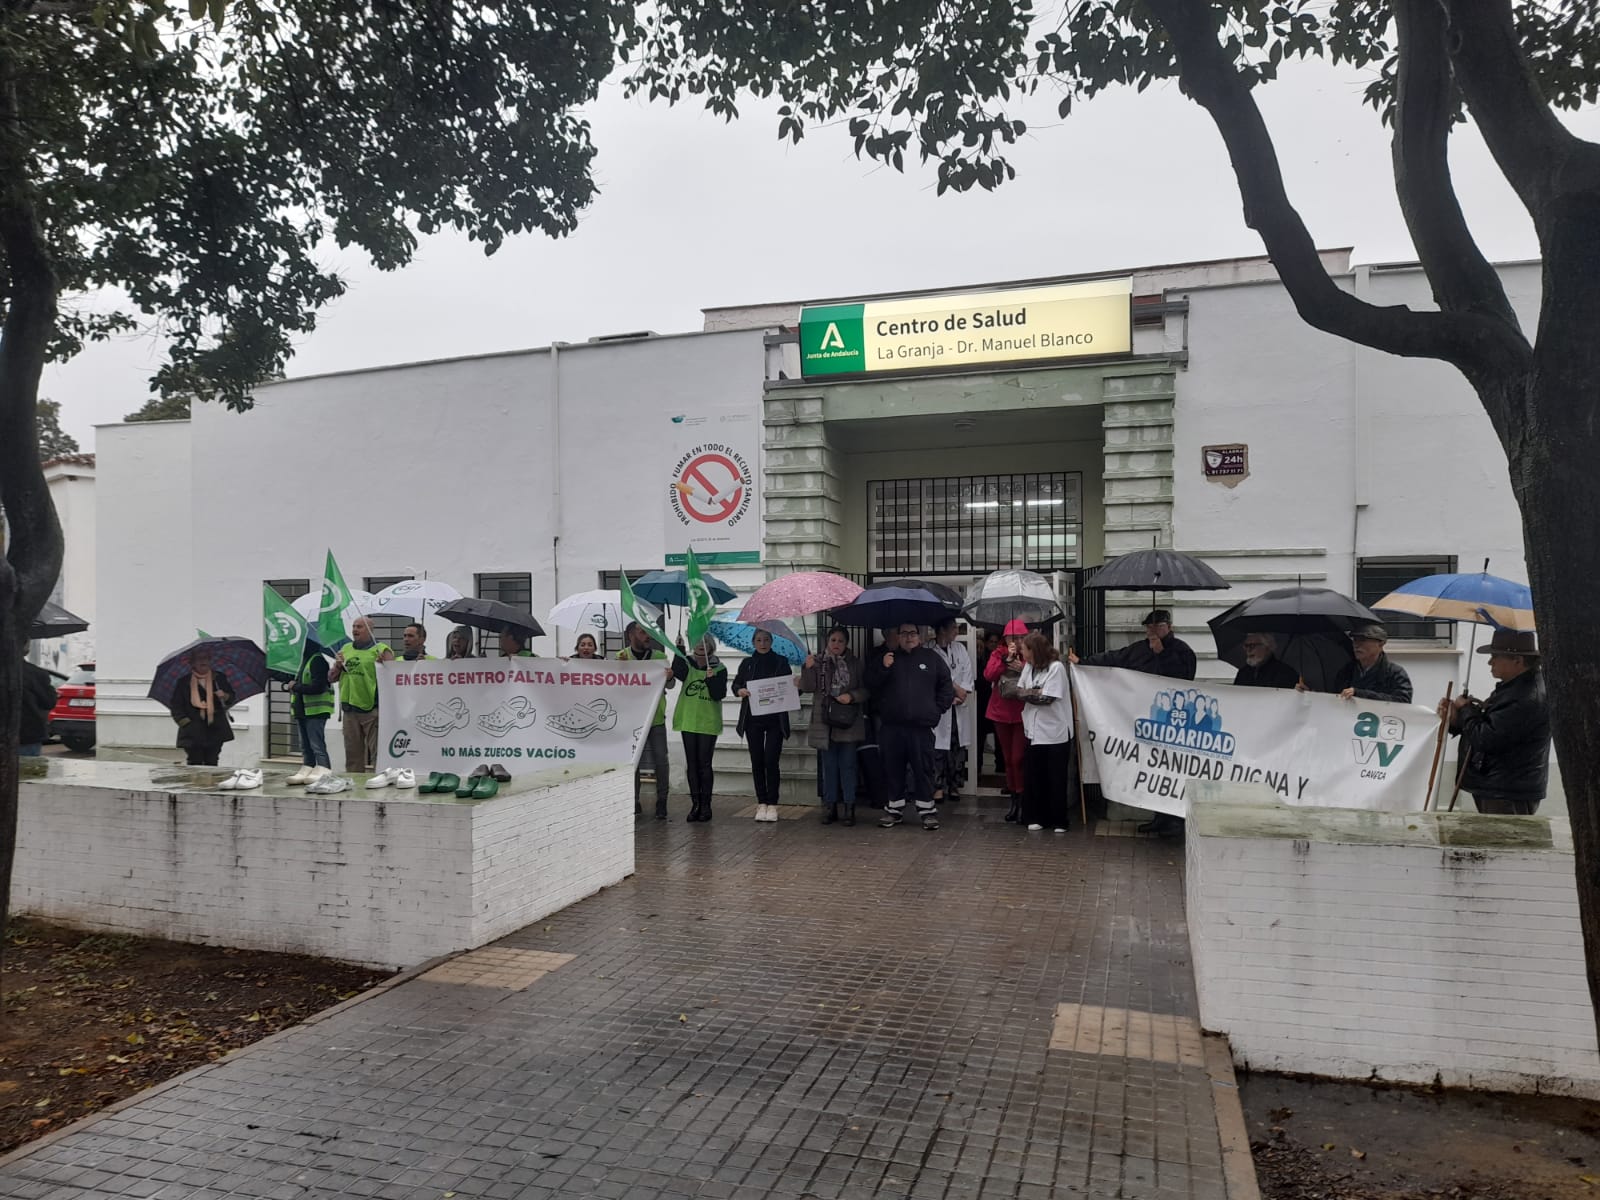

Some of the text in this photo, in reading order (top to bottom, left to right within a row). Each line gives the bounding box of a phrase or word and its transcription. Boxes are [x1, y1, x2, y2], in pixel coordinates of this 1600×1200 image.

[877, 308, 1026, 337] Centro de Salud
[806, 352, 822, 360] Junta
[878, 345, 895, 360] La
[898, 341, 944, 360] Granja
[957, 340, 978, 354] Dr.
[982, 334, 1036, 352] Manuel
[1040, 332, 1094, 347] Blanco
[1224, 456, 1243, 464] 24h
[670, 444, 752, 527] PROHIBIDO FUMAR EN TODO EL RECINTO SANITARIO
[396, 670, 651, 686] EN ESTE CENTRO FALTA PERSONAL
[1134, 719, 1236, 752] SOLIDARIDAD
[441, 744, 576, 758] NO MÁS ZUECOS VACÍOS
[1104, 736, 1139, 763] UNA
[1147, 747, 1224, 780] SANIDAD
[1298, 776, 1310, 800] Y
